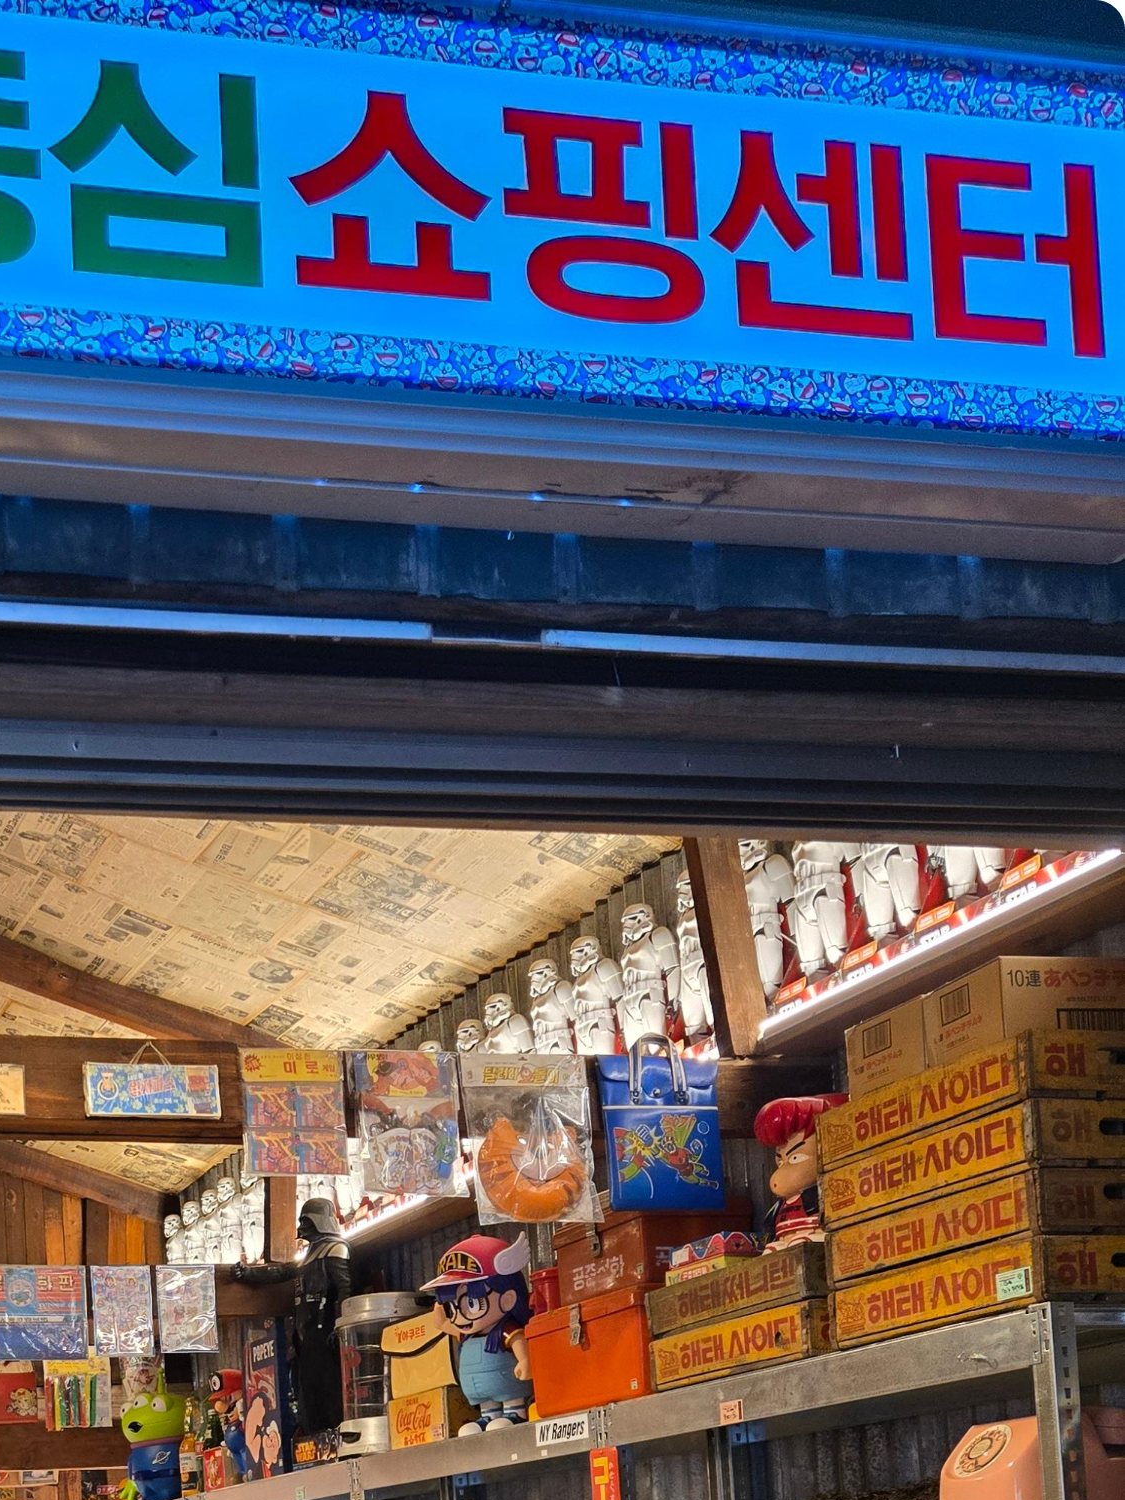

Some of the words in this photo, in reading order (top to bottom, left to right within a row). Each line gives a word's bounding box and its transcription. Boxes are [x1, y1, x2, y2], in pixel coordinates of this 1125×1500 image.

[1043, 1043, 1087, 1078] 해
[854, 1093, 913, 1142] 해태
[918, 1052, 1011, 1119] 사이다
[858, 1150, 917, 1198] 해태
[922, 1116, 1017, 1178] 사이다
[866, 1218, 926, 1263] 해태
[931, 1187, 1026, 1247] 사이다
[866, 1280, 926, 1325] 해태
[252, 1339, 275, 1363] POPEYE
[679, 1333, 726, 1370] 해태
[728, 1313, 799, 1360] 사이다
[539, 1425, 551, 1443] NY
[551, 1419, 586, 1441] Rangers
